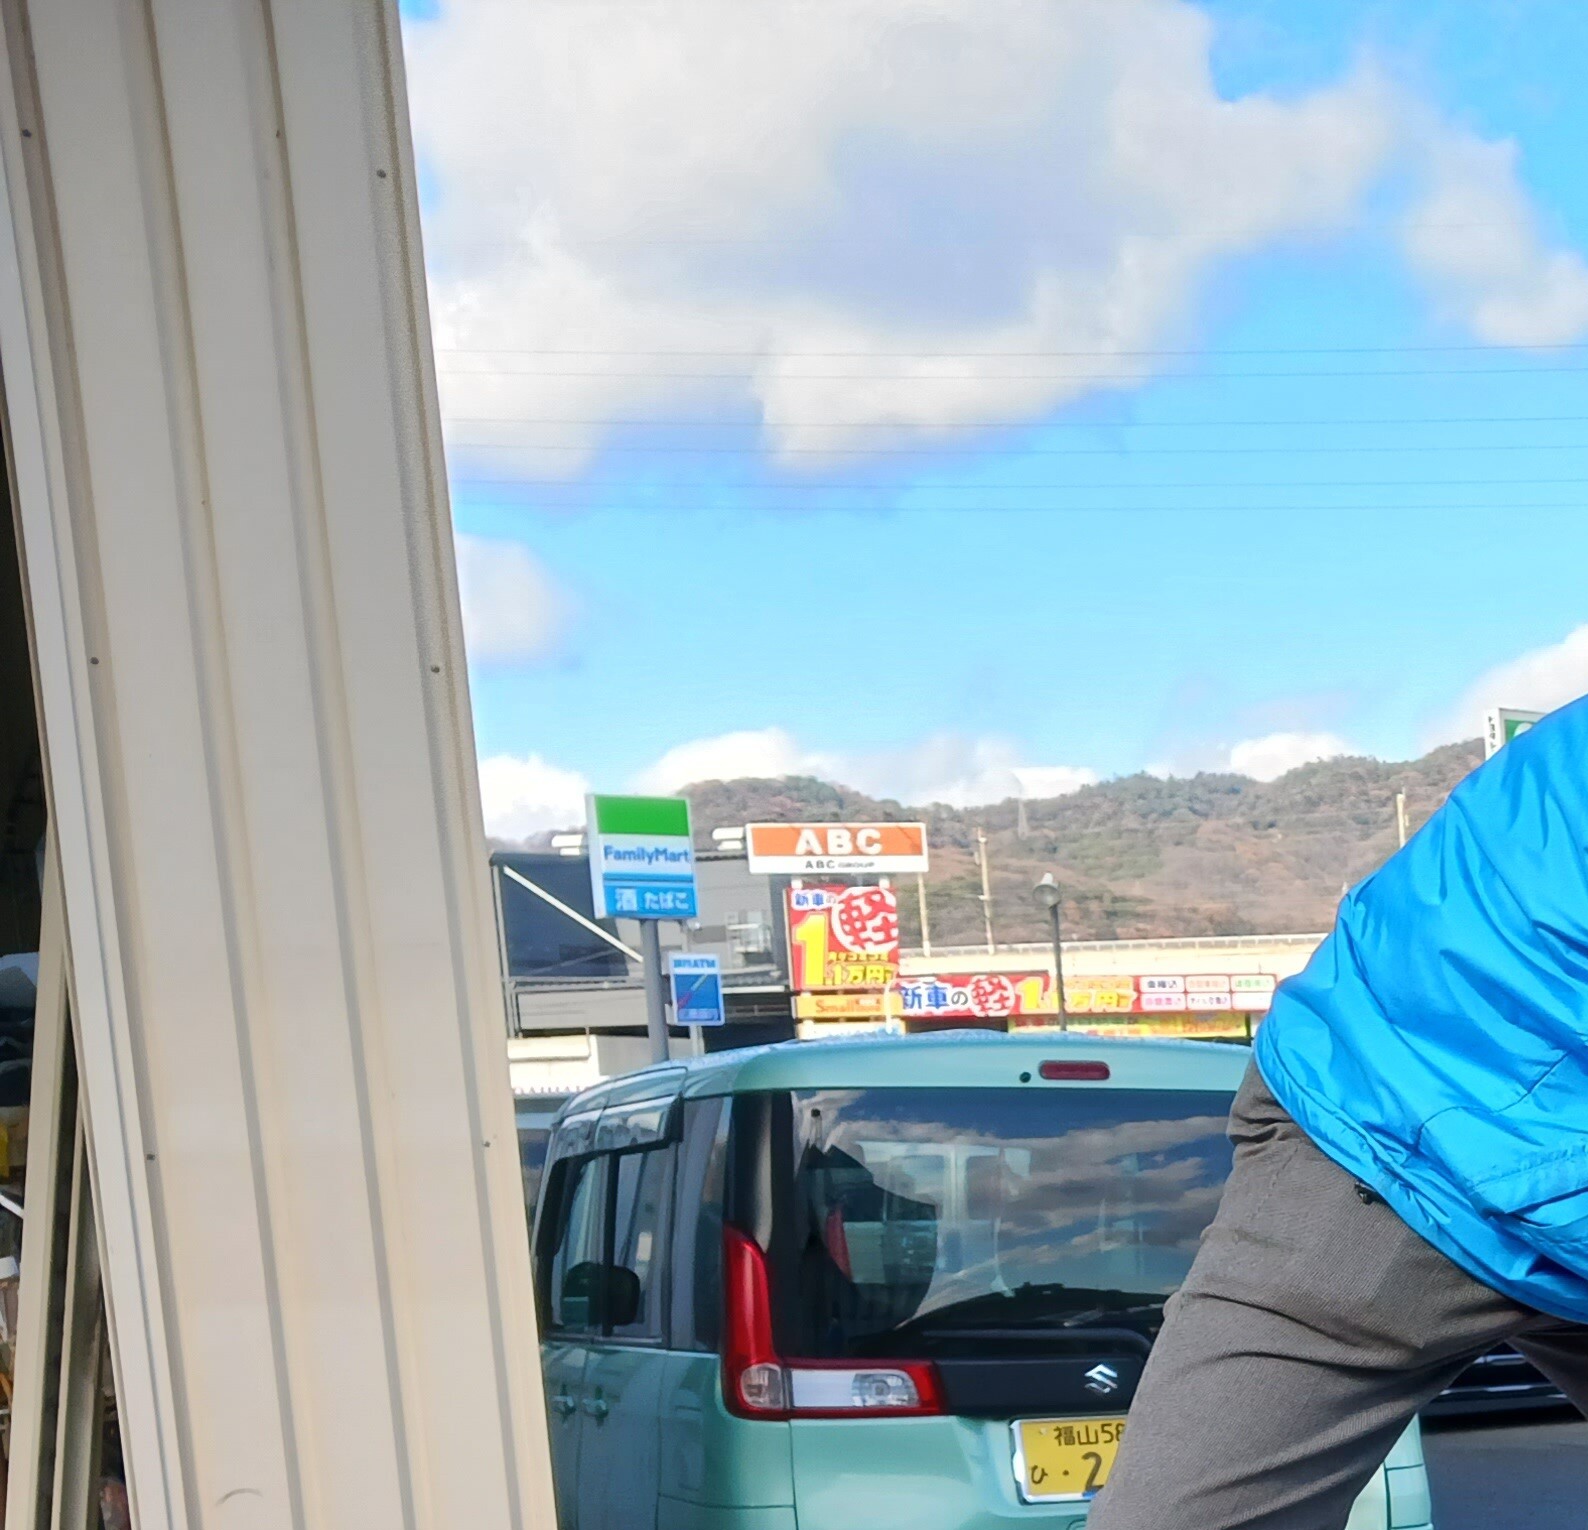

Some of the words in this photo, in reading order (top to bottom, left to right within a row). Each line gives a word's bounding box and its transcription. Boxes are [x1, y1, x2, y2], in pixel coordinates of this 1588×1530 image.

[795, 828, 883, 856] ABC
[603, 845, 690, 865] FamilyMart
[805, 860, 836, 870] ABC
[644, 892, 690, 910] たばこ
[1030, 1464, 1048, 1485] ひ
